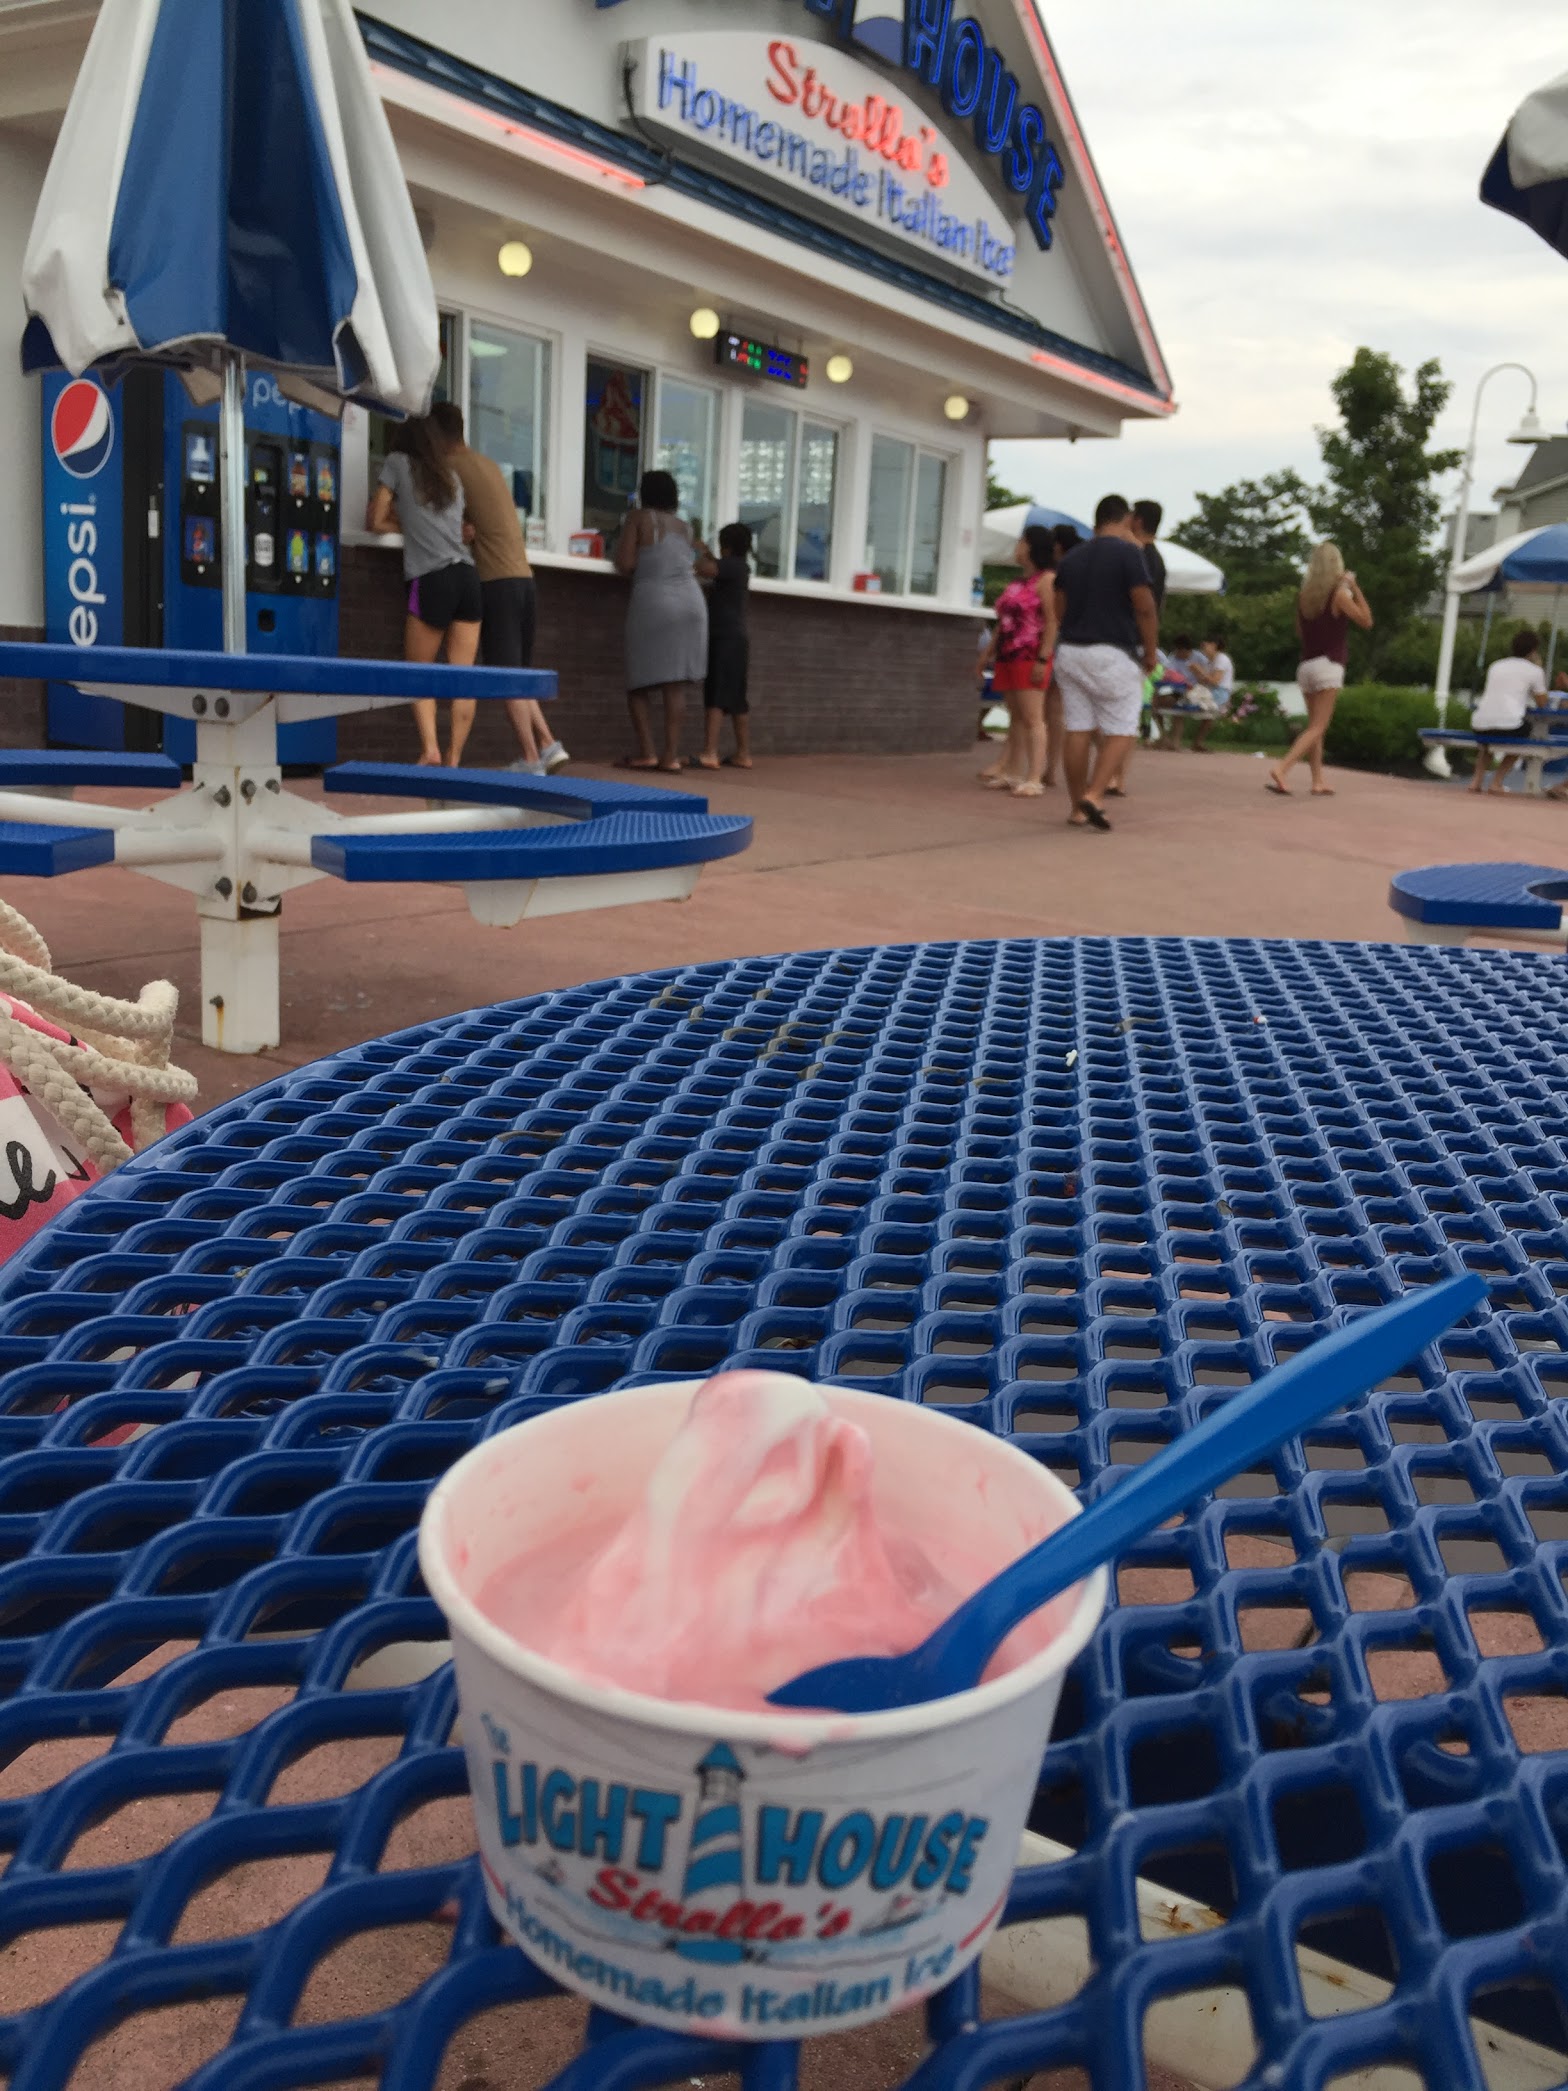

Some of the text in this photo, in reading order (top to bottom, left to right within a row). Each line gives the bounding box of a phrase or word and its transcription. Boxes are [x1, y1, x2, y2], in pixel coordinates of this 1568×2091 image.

[656, 48, 1017, 277] Homemade Italian Ice
[60, 502, 107, 648] epsi
[491, 1760, 989, 1894] LIGHT HOUSE
[504, 1883, 956, 2024] Homemade Italian Ice
